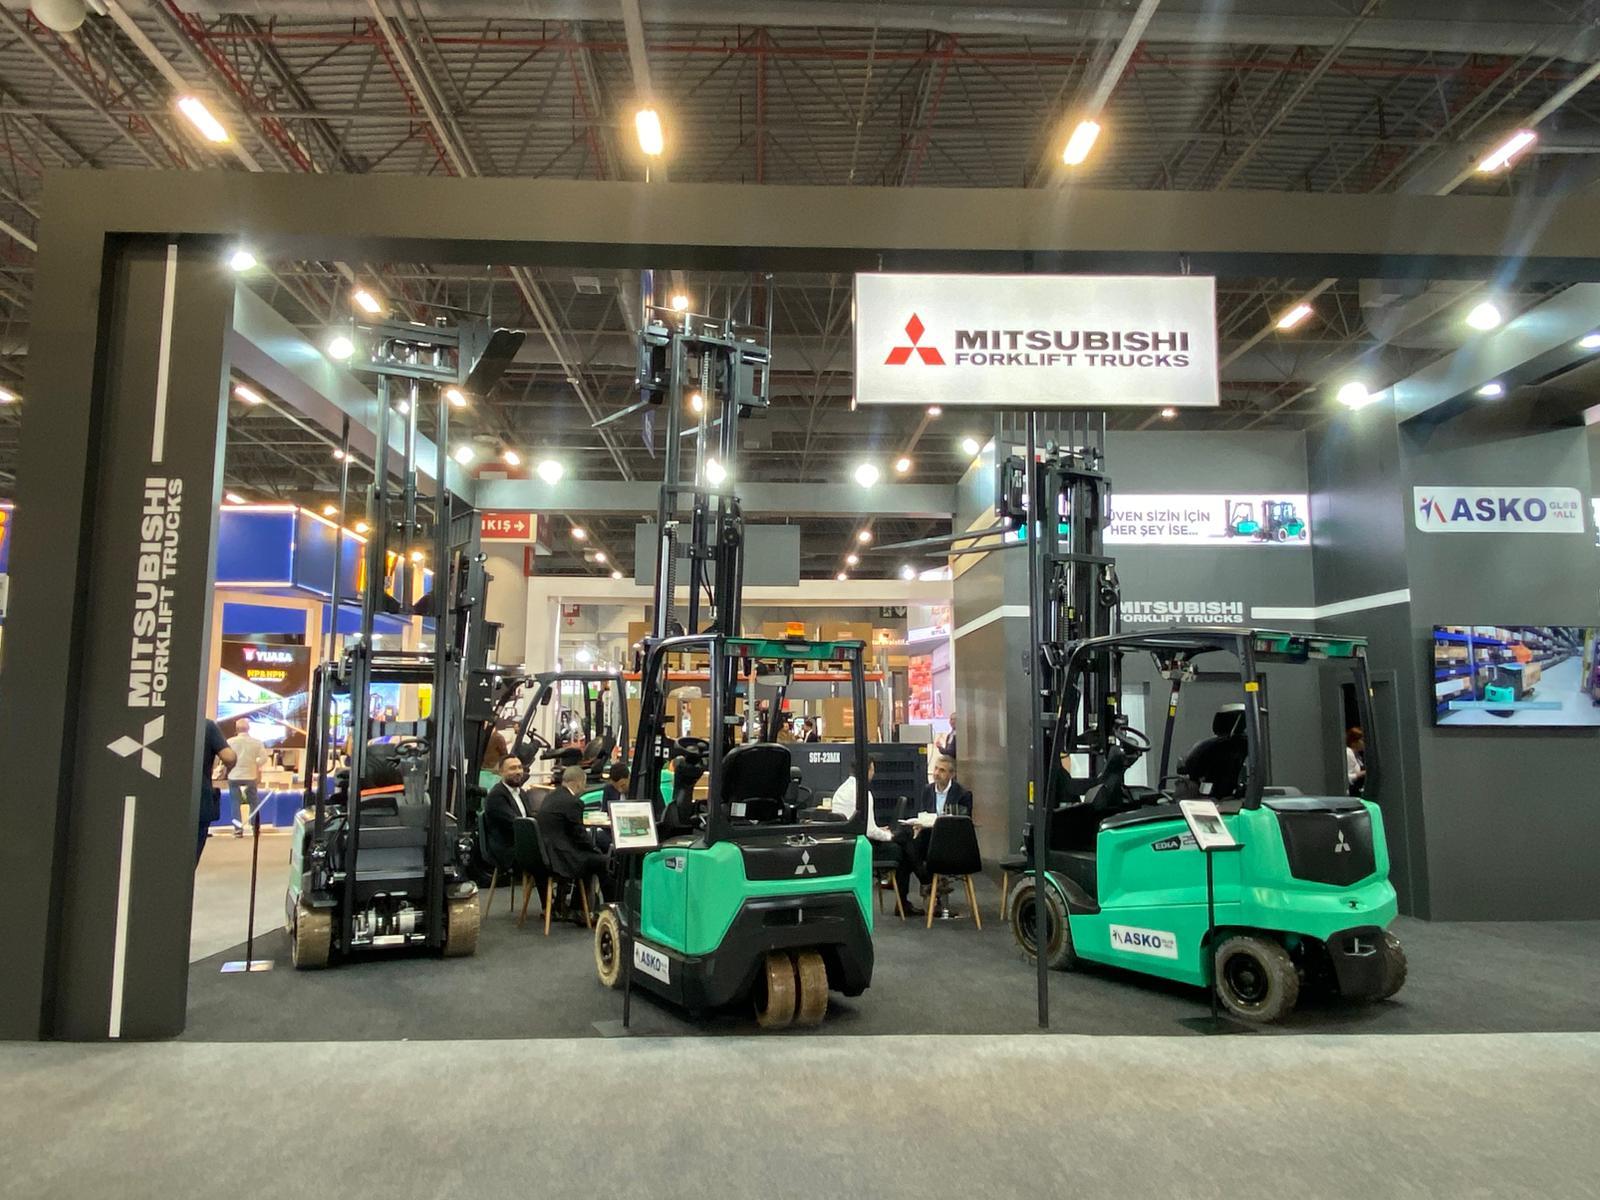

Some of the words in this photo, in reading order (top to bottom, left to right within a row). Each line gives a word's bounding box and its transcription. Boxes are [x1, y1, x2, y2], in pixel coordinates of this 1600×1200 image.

[955, 330, 1189, 351] MITSUBISHI
[955, 353, 1077, 366] FORKLIFT
[1084, 353, 1189, 367] TRUCKS
[1147, 509, 1180, 521] SİZİN
[1184, 509, 1210, 523] İÇİN
[1451, 498, 1547, 522] ASKO
[162, 478, 183, 579] TRUCKS
[481, 520, 511, 533] IKIŞ
[1111, 525, 1137, 535] HER
[1140, 525, 1164, 537] ŞEY
[128, 477, 167, 707] MITSUBISHI
[1120, 602, 1243, 614] MITSUBISHI
[1186, 614, 1243, 623] TRUCKS
[152, 586, 175, 707] FORKLIFT
[256, 651, 293, 662] YUASA
[1124, 931, 1161, 949] ASKO
[640, 951, 661, 971] ASKO
